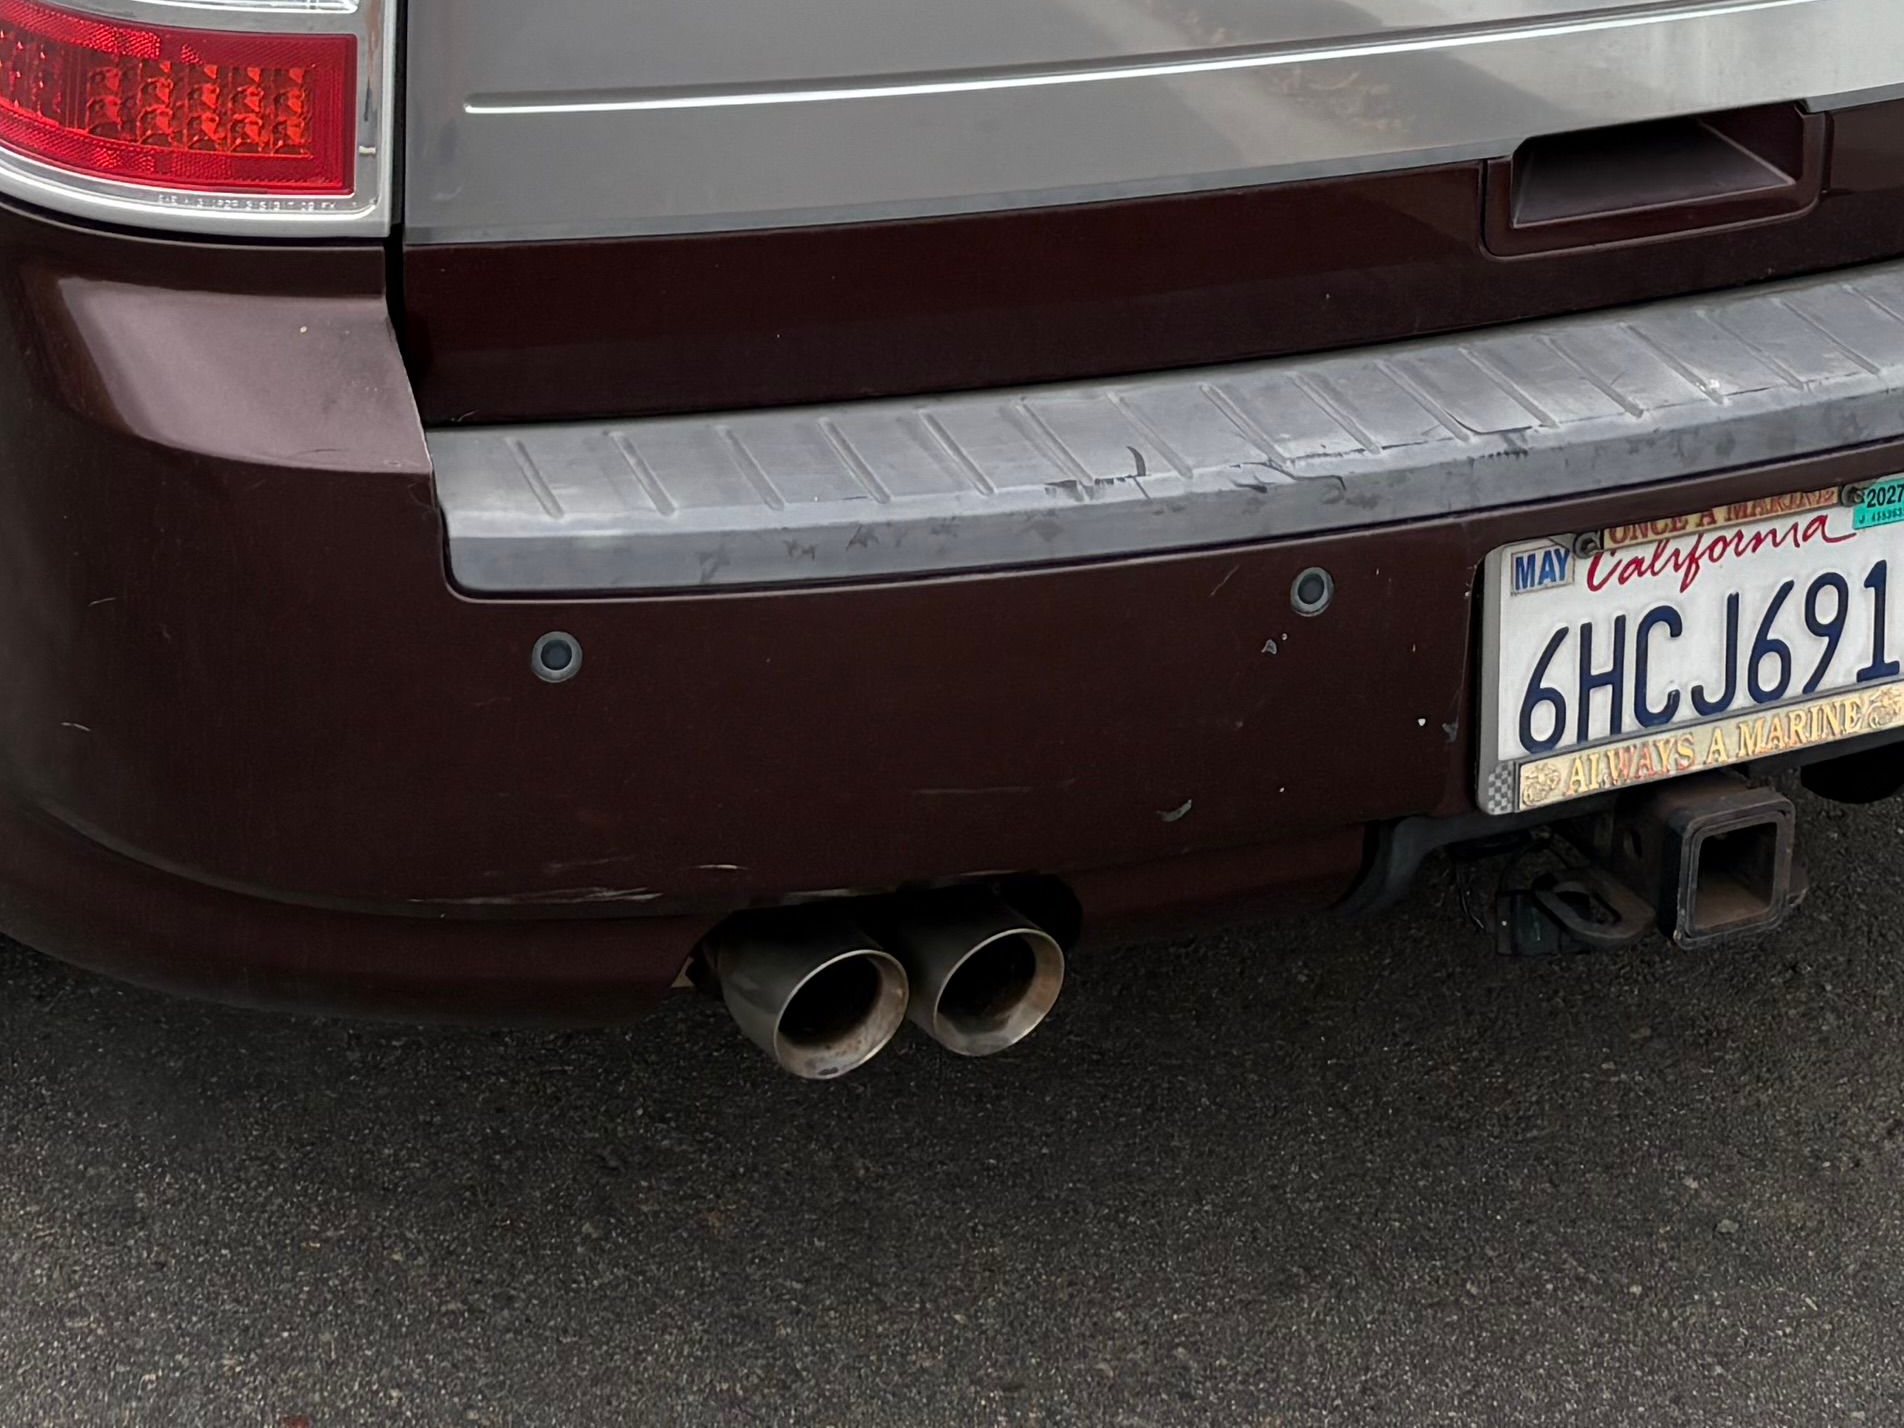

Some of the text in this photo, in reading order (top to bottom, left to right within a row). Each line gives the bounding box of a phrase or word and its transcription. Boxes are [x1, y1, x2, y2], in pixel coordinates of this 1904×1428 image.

[1514, 551, 1571, 591] MAY
[1586, 514, 1857, 593] California
[1519, 559, 1901, 754] 6HCJ691
[1565, 694, 1866, 798] ALWAYS A MARINE
